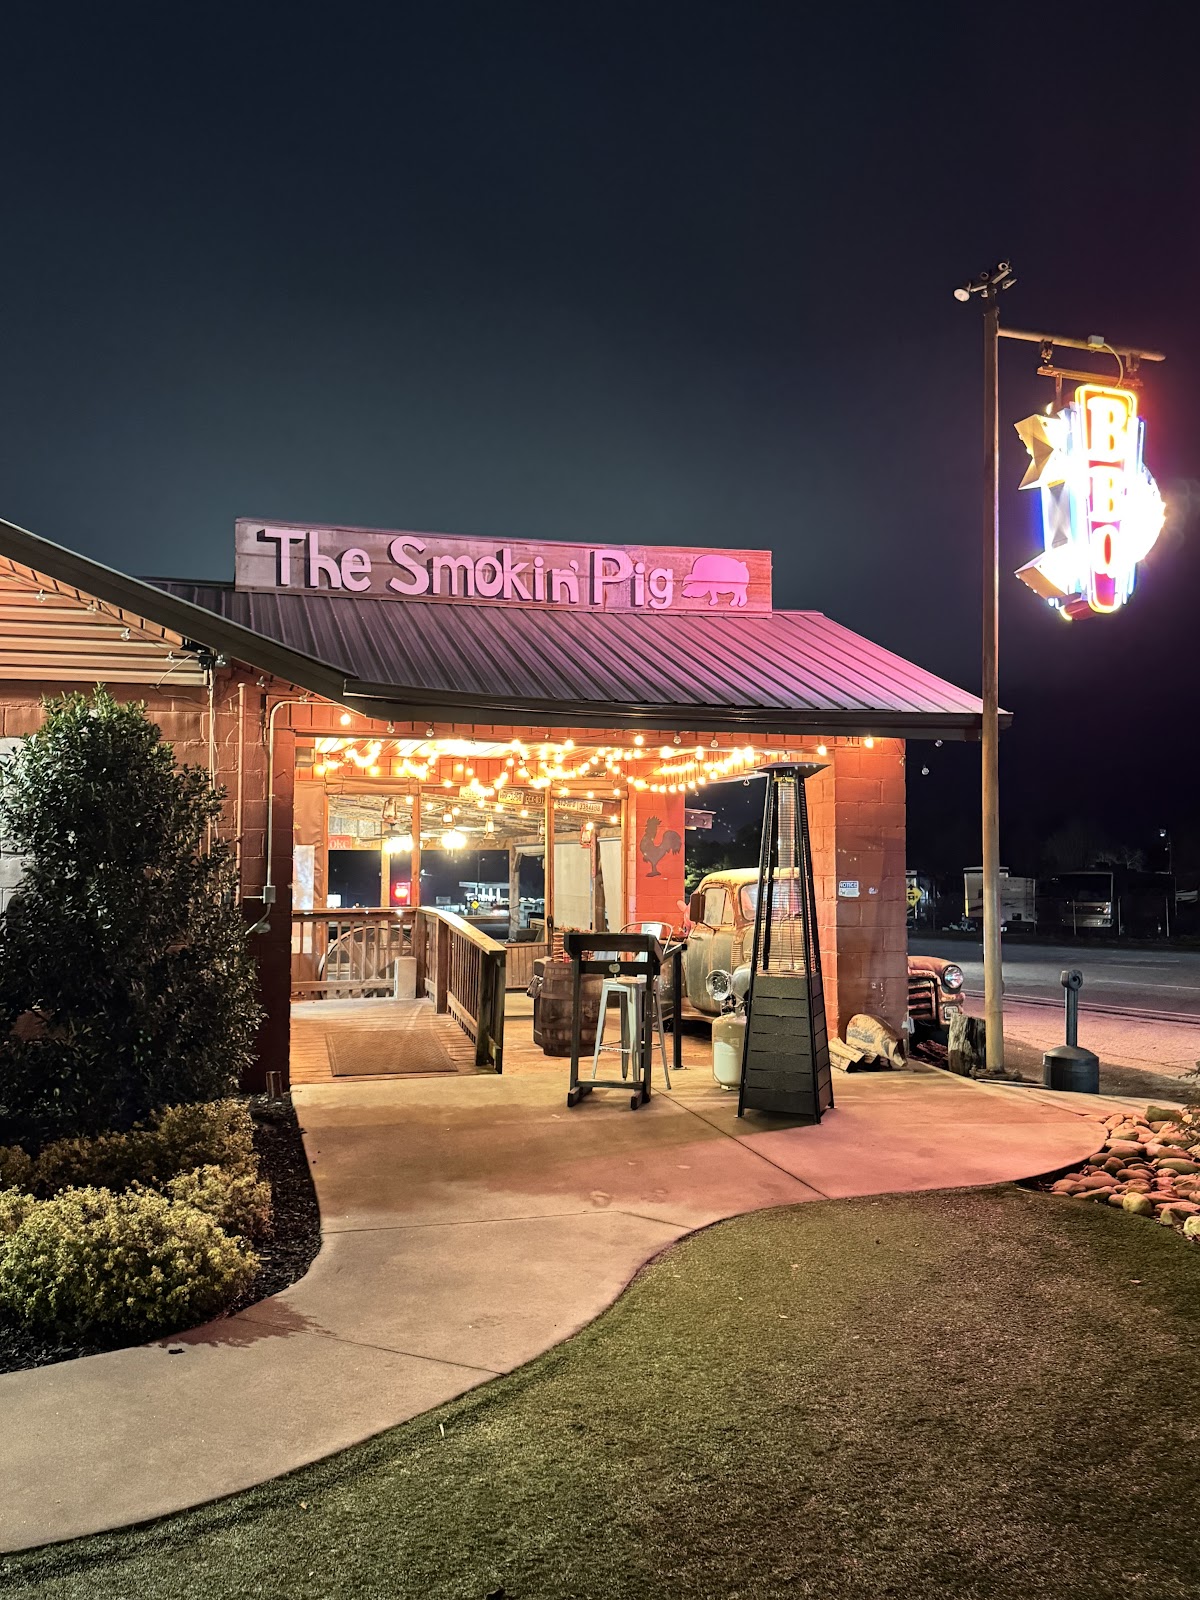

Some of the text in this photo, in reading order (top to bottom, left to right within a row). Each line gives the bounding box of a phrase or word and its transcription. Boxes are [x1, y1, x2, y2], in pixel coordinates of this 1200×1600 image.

[1086, 396, 1129, 578] BBQ
[258, 528, 674, 610] The Smokin' Pig
